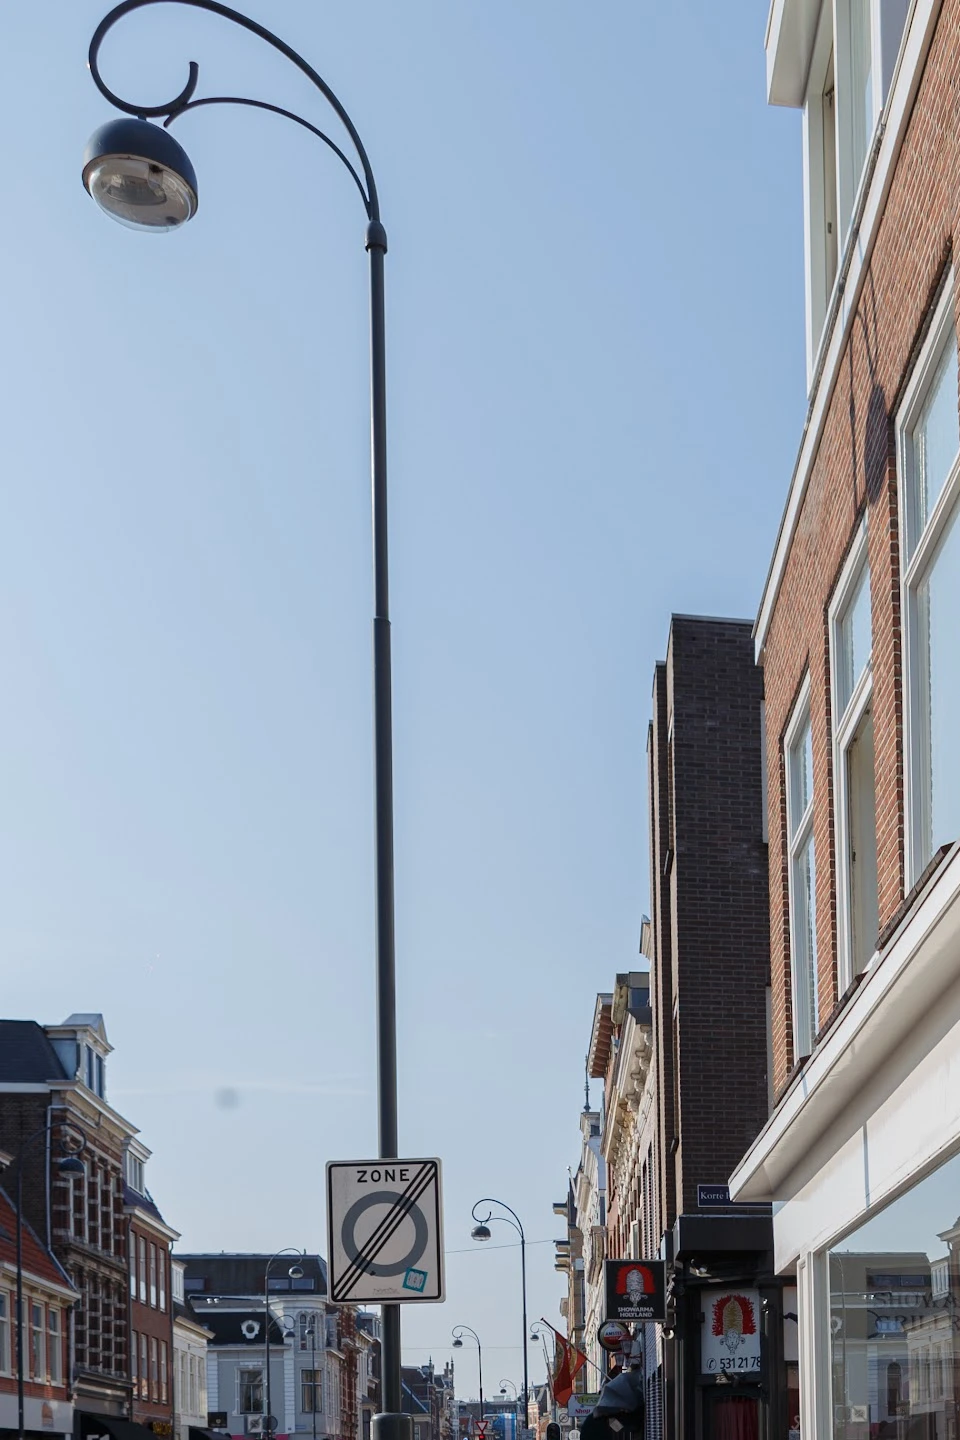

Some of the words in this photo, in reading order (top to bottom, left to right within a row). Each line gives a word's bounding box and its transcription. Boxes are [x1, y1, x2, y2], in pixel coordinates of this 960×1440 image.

[357, 1169, 410, 1182] ZONE
[700, 1191, 724, 1200] Korte
[719, 1358, 736, 1370] 531
